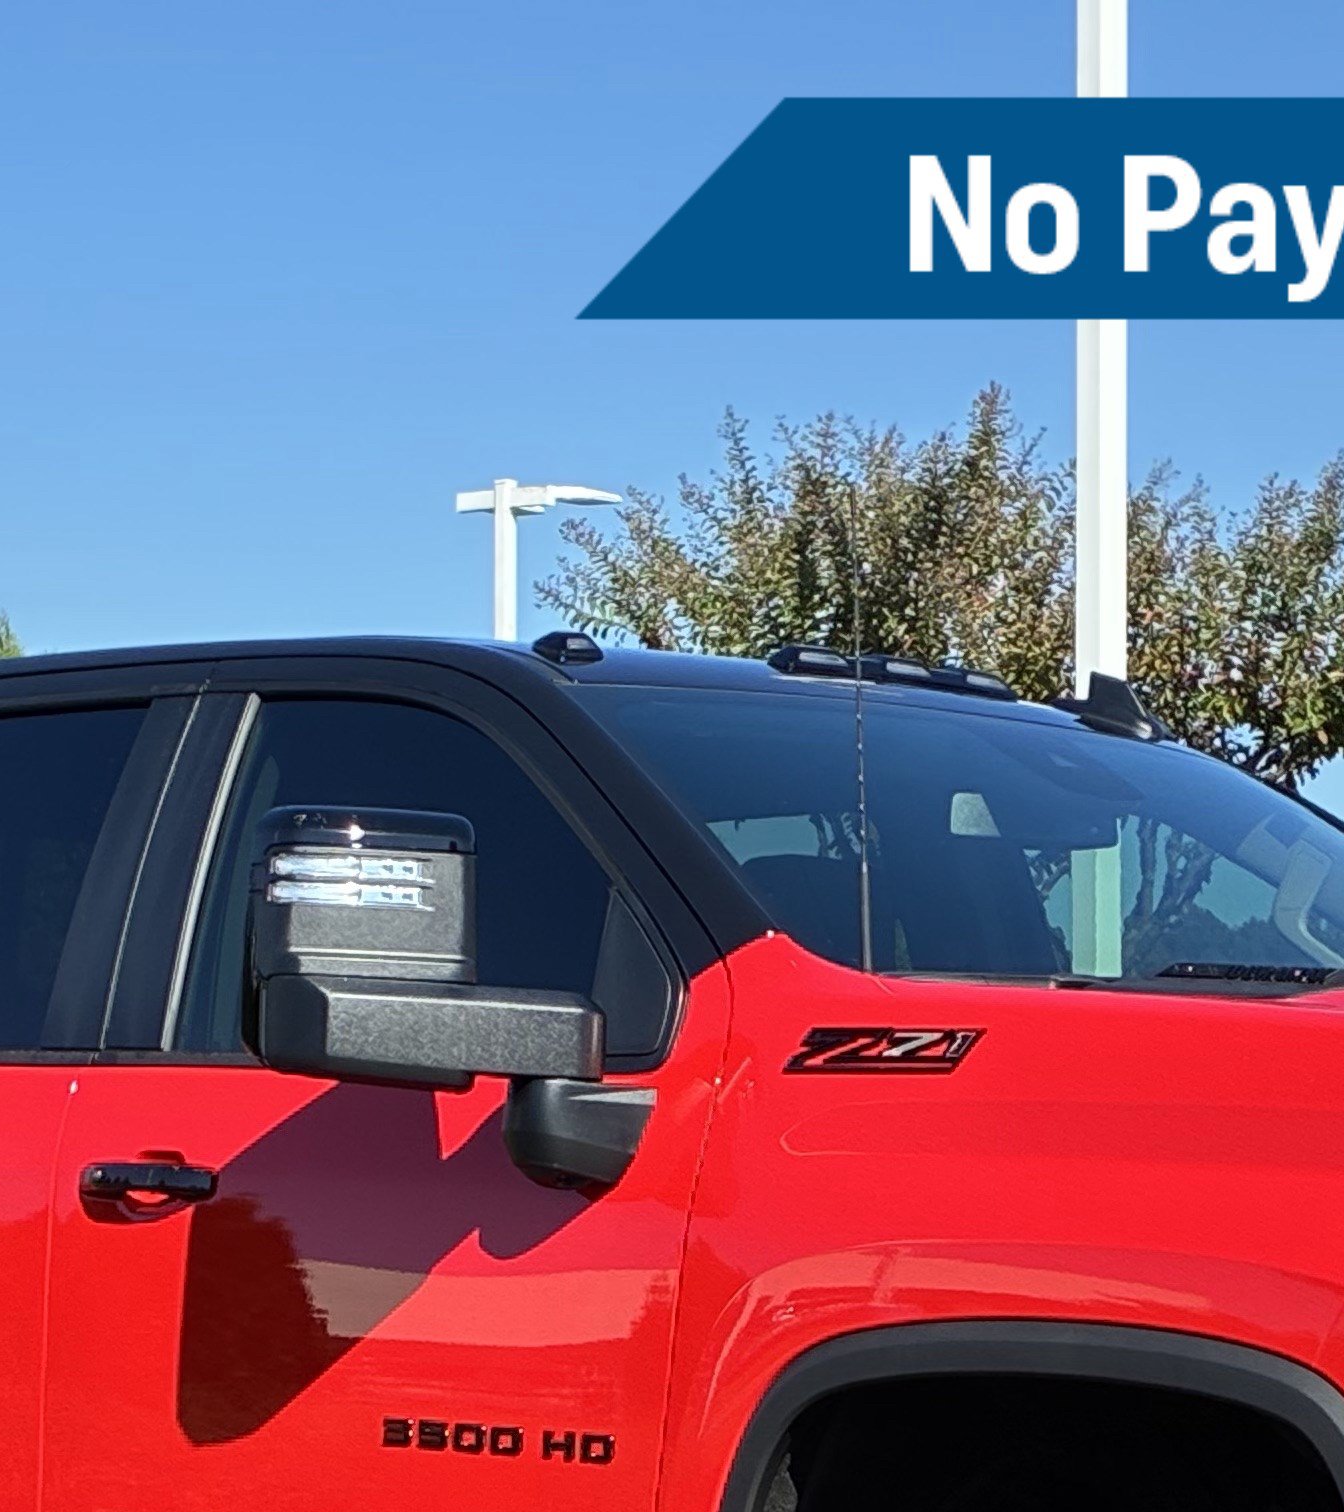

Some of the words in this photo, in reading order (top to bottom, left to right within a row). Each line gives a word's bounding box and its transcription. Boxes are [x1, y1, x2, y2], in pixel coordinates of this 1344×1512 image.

[782, 1027, 988, 1076] Z71
[381, 1416, 524, 1456] 3500
[540, 1430, 616, 1466] HD
